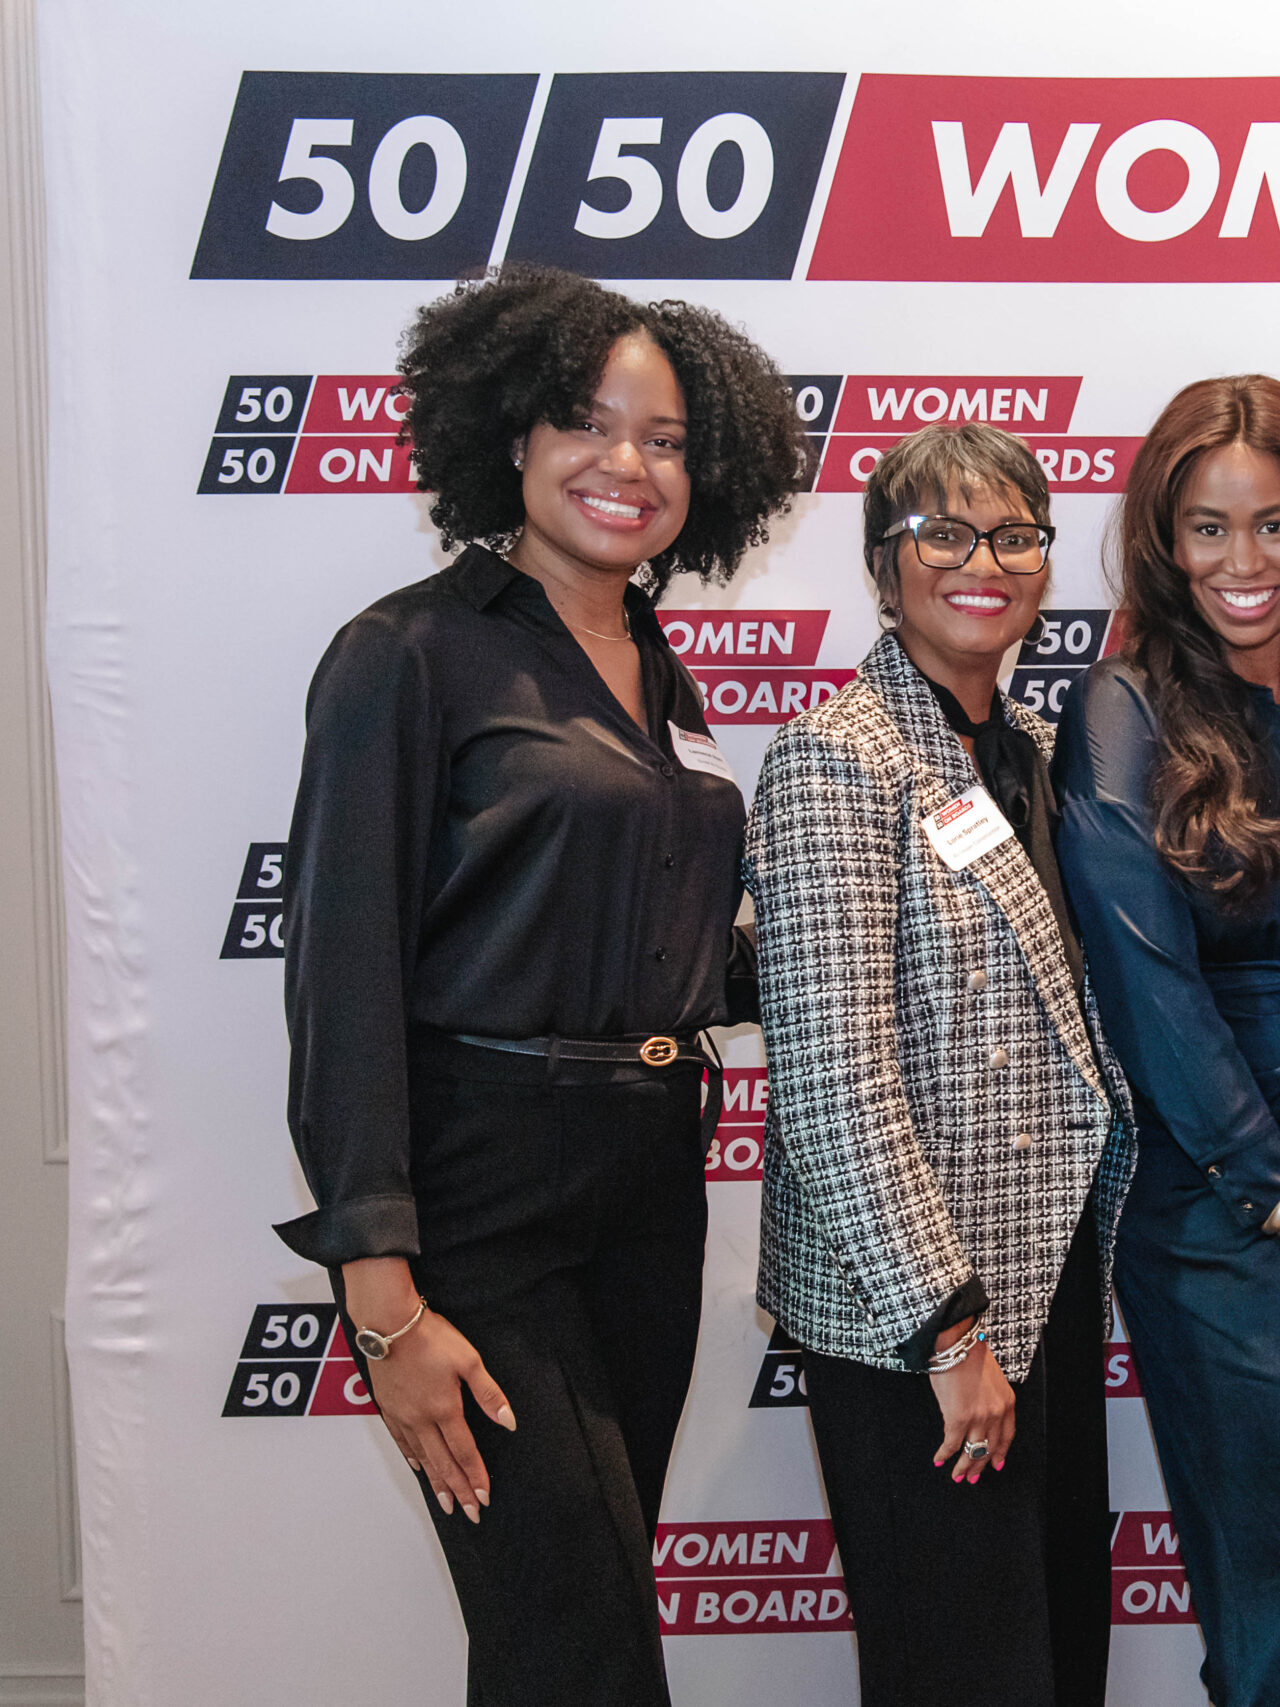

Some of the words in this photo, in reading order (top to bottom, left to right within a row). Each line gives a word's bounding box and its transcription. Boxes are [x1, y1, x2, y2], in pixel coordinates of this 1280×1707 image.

[266, 116, 467, 240] 50
[574, 113, 773, 239] 50
[236, 387, 293, 422] 50
[868, 388, 1048, 421] WOMEN
[218, 448, 275, 483] 50
[320, 448, 393, 482] ON
[1033, 448, 1115, 482] RDS
[661, 621, 796, 655] OMEN
[1036, 619, 1092, 655] 50
[699, 680, 843, 715] OARD
[256, 854, 282, 888] 5
[261, 1314, 319, 1348] 50
[243, 1372, 300, 1406] 50
[694, 1588, 854, 1624] BOARD
[1121, 1580, 1191, 1614] ON
